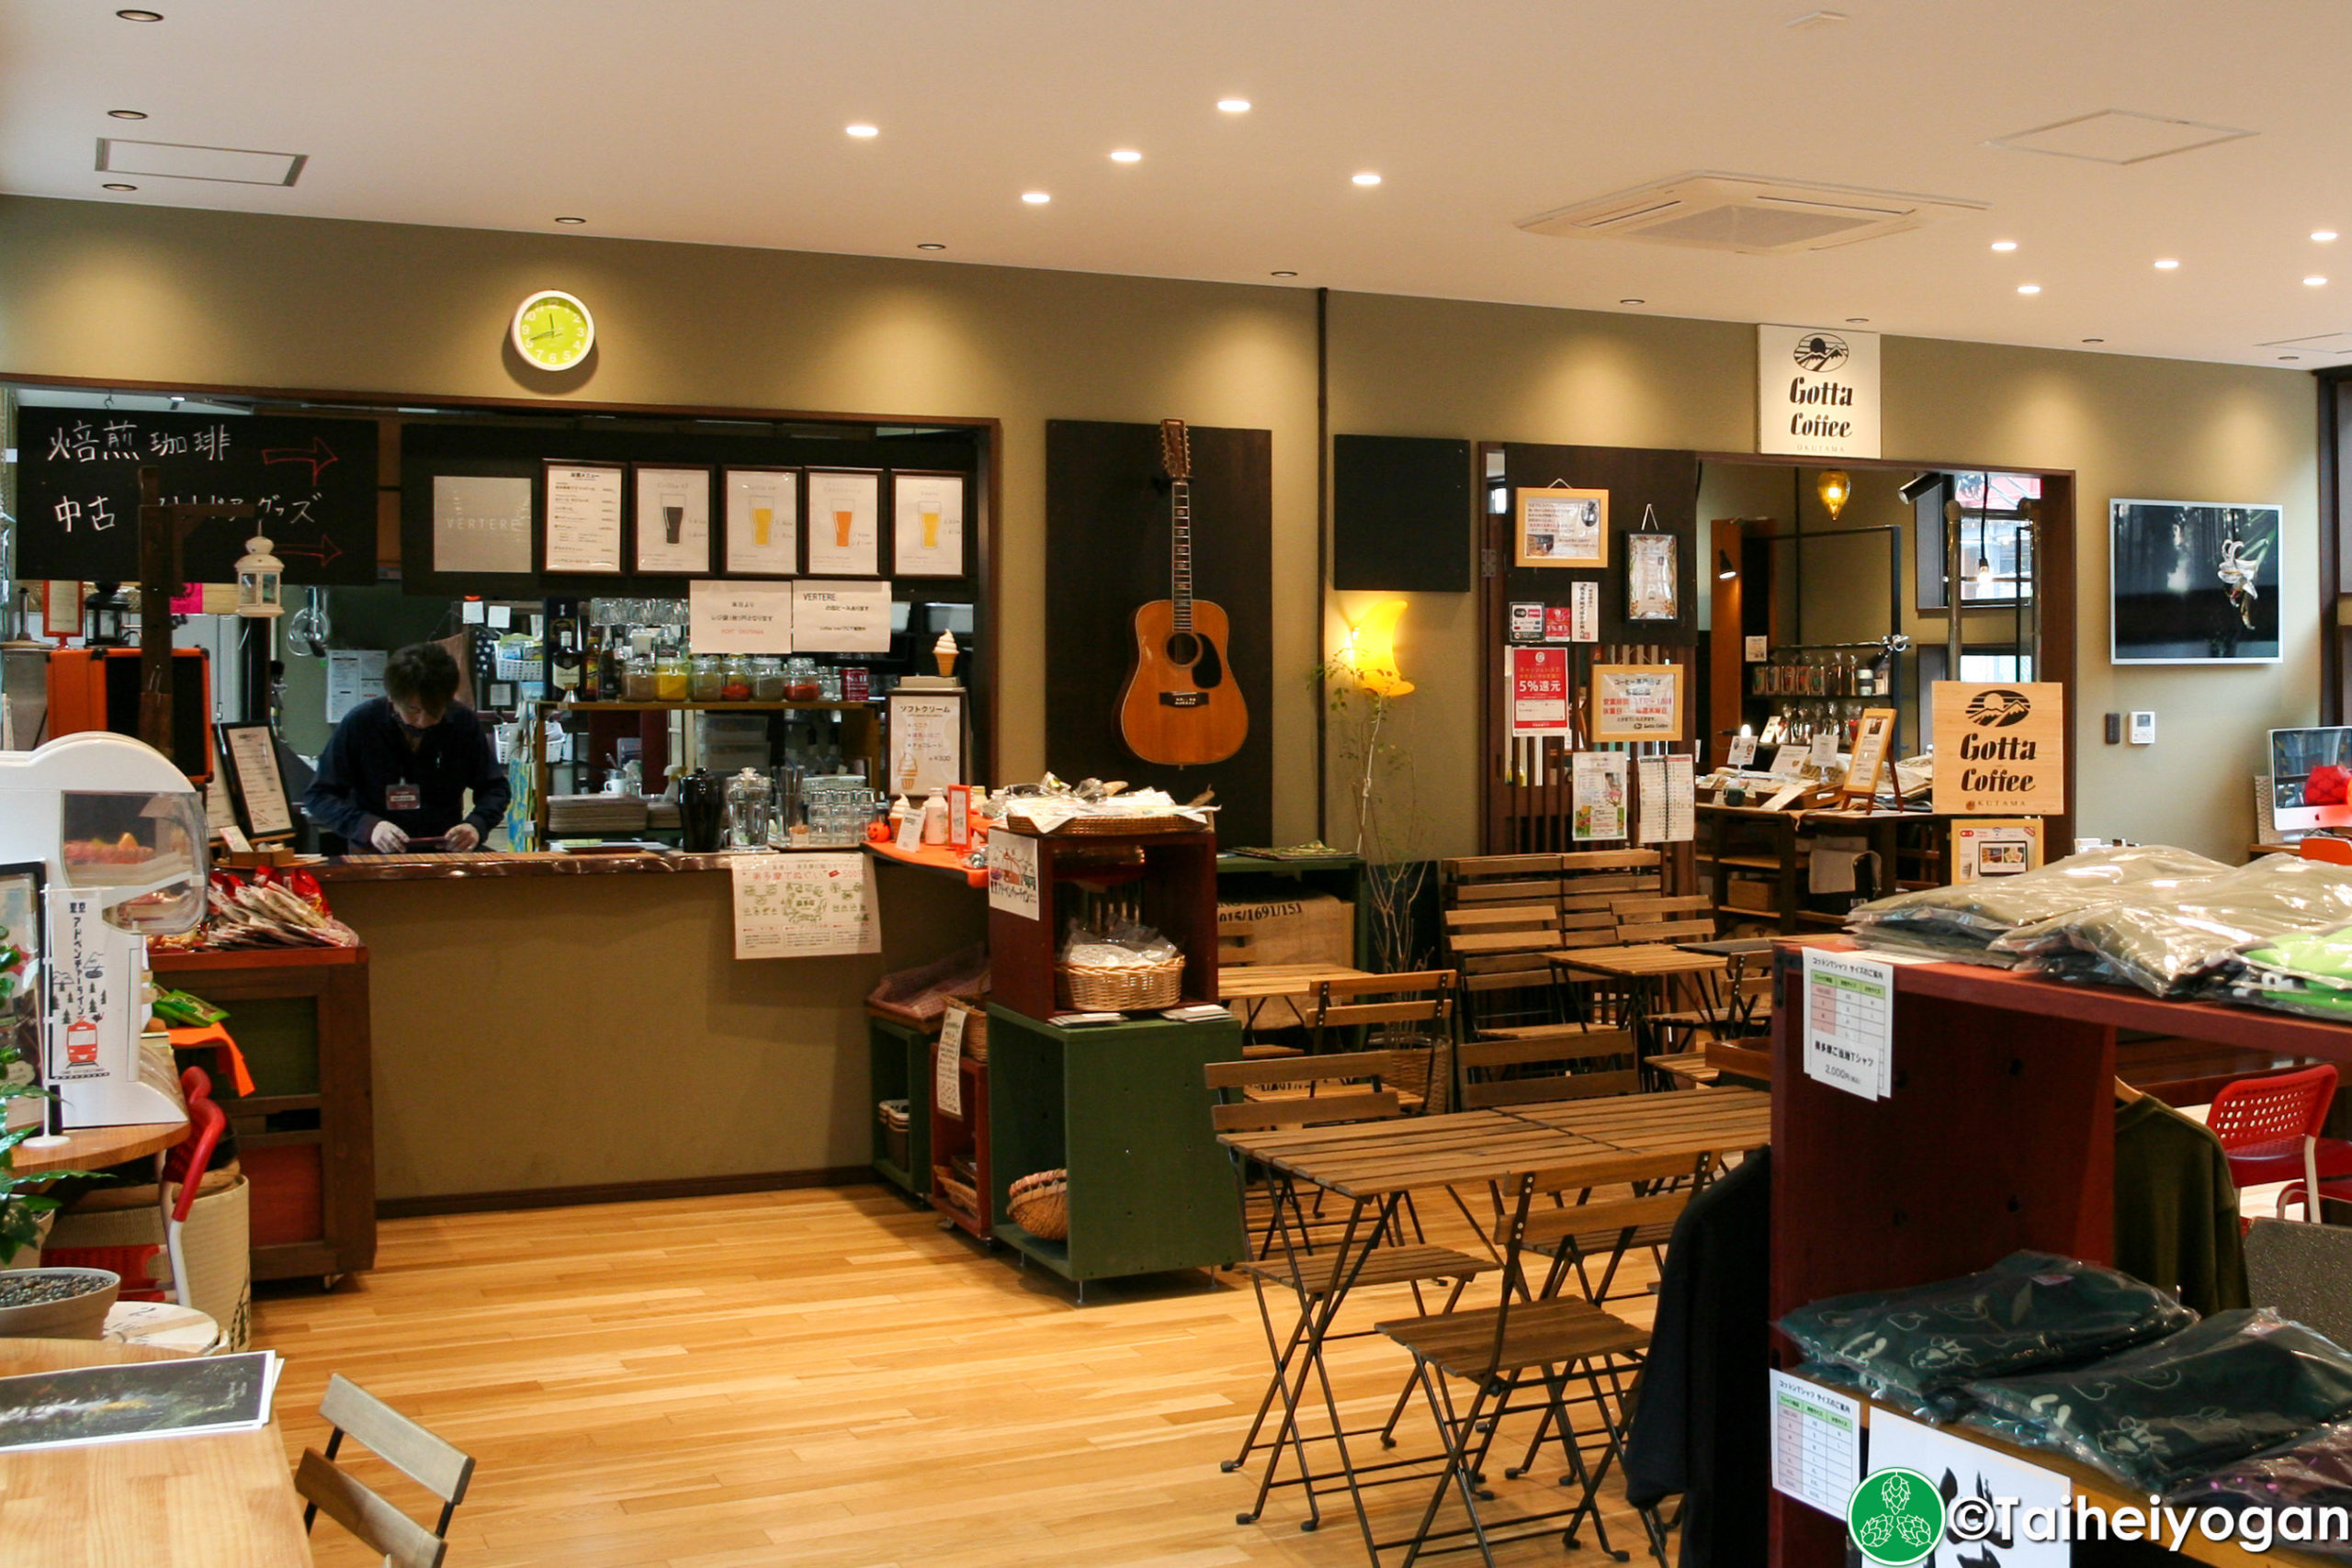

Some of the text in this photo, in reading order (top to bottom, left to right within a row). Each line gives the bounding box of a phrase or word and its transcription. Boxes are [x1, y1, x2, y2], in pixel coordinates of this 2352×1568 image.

[573, 313, 581, 322] 2
[522, 325, 529, 335] 9
[577, 327, 584, 337] 3
[573, 341, 581, 350] 4
[537, 350, 544, 360] 7
[548, 353, 557, 363] 6
[563, 351, 571, 361] 5
[1790, 377, 1853, 406] Gotta
[1791, 412, 1853, 438] Coffee
[1797, 444, 1845, 452] OKUTAMA
[803, 592, 837, 602] VERTERE
[1519, 680, 1561, 693] 5%還元
[1960, 733, 2036, 761] Gotta
[1961, 768, 2036, 792] Coffee
